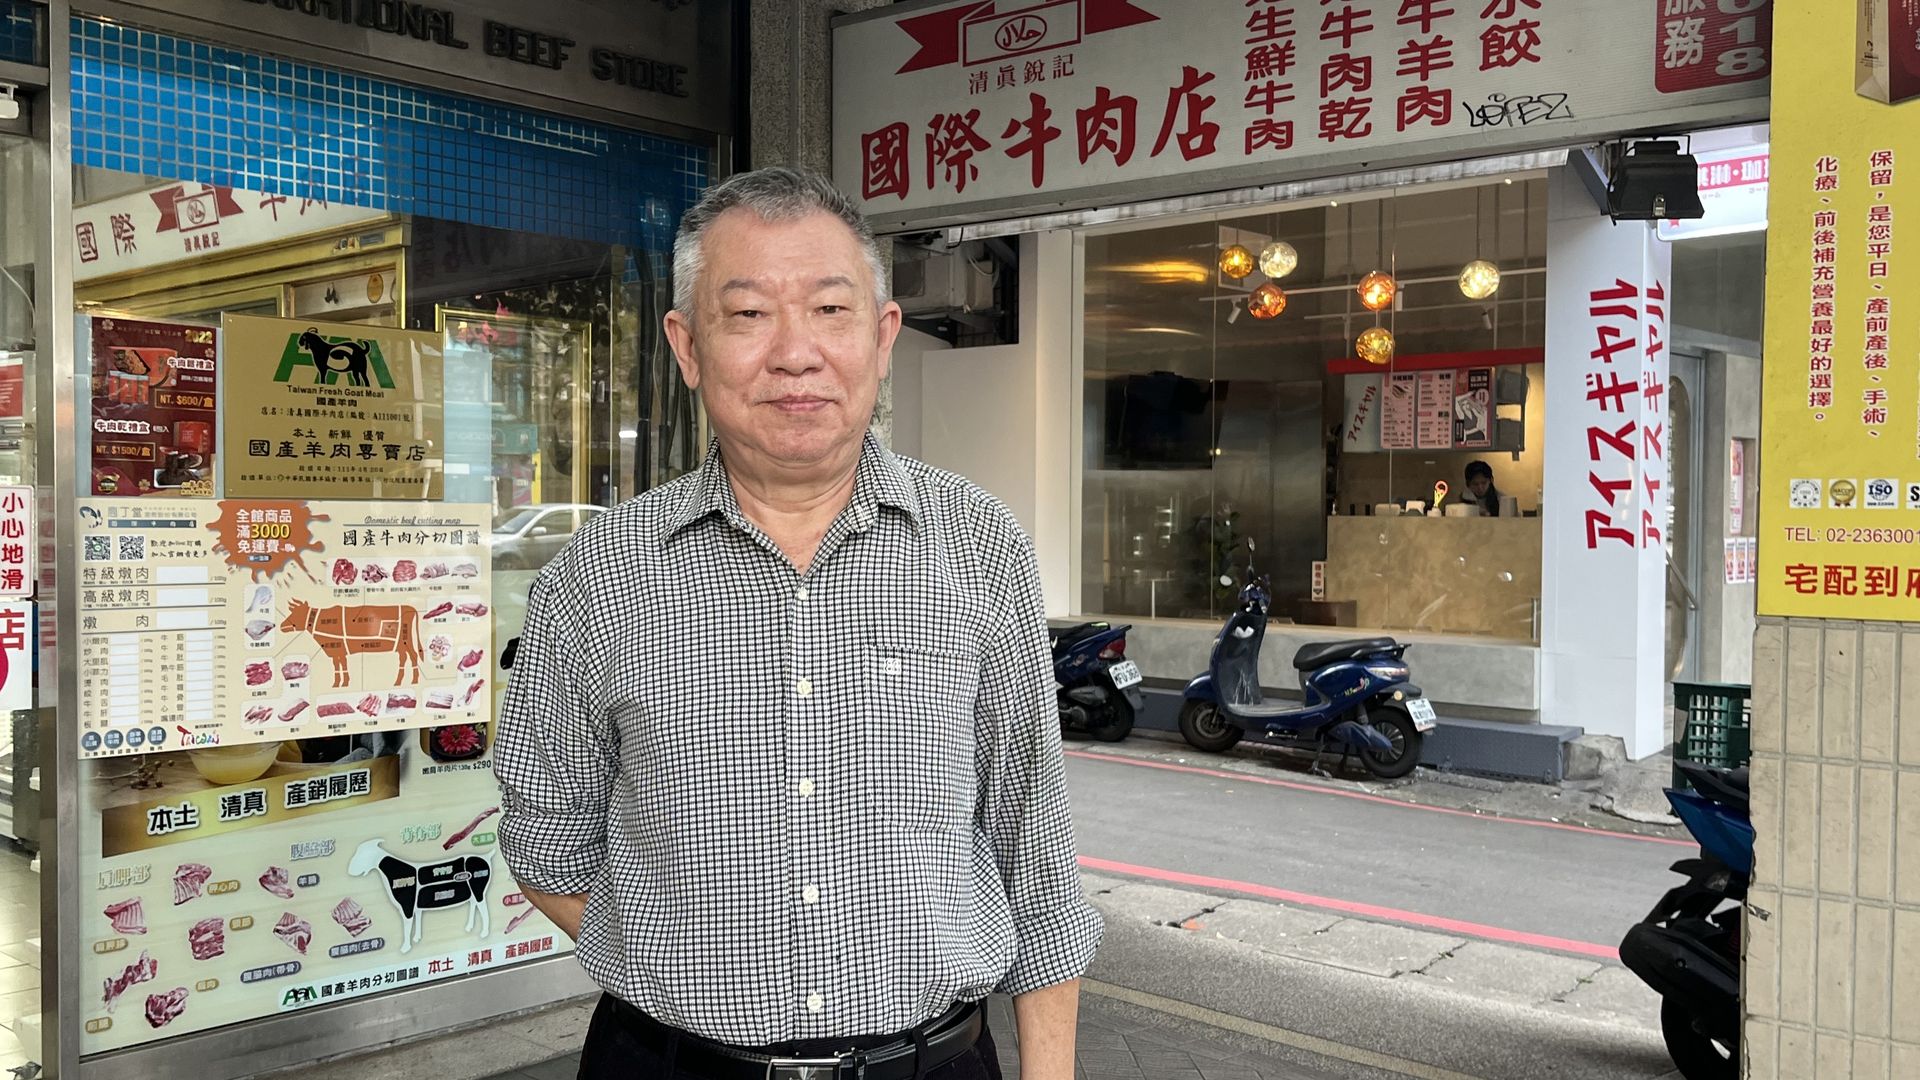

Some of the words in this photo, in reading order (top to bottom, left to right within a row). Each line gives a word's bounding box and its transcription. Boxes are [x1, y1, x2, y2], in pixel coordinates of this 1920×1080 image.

[484, 20, 576, 70] BEEF
[590, 47, 690, 97] STORE
[1244, 0, 1297, 156] 生鮮牛肉
[1317, 0, 1375, 143] 牛肉乾
[861, 66, 1221, 200] 國際牛肉店
[76, 213, 137, 263] 國際
[185, 329, 213, 344] 2022
[287, 385, 317, 394] Taiwan
[319, 386, 342, 396] Fresh
[344, 388, 364, 397] Goat
[365, 389, 384, 398] Meat
[316, 397, 357, 407] 國產羊肉
[1585, 278, 1639, 549] アイスギャル
[1642, 279, 1665, 549] アイスギャル
[292, 428, 316, 439] 本土
[328, 429, 352, 440] 新鮮
[249, 439, 425, 461] 國產羊肉專賣店
[1868, 484, 1893, 496] ISO
[236, 509, 291, 523] 全館商品
[364, 515, 399, 524] Domestic
[401, 515, 415, 526] beef
[236, 524, 291, 539] 滿3000
[343, 529, 481, 546] 國產牛肉分切圖譜
[1785, 527, 1821, 542] TEL:
[1, 493, 24, 590] 小心地滑
[237, 540, 279, 553] 免運費
[83, 567, 149, 580] 特級燉肉
[83, 589, 149, 603] 高級燉肉
[473, 760, 491, 769] $290
[150, 805, 196, 832] 本土
[221, 789, 266, 818] 清真
[287, 771, 370, 805] 產銷履歷
[321, 967, 419, 997] 國產羊肉分切圖譜
[428, 958, 454, 974] 本土
[467, 950, 493, 967] 清真
